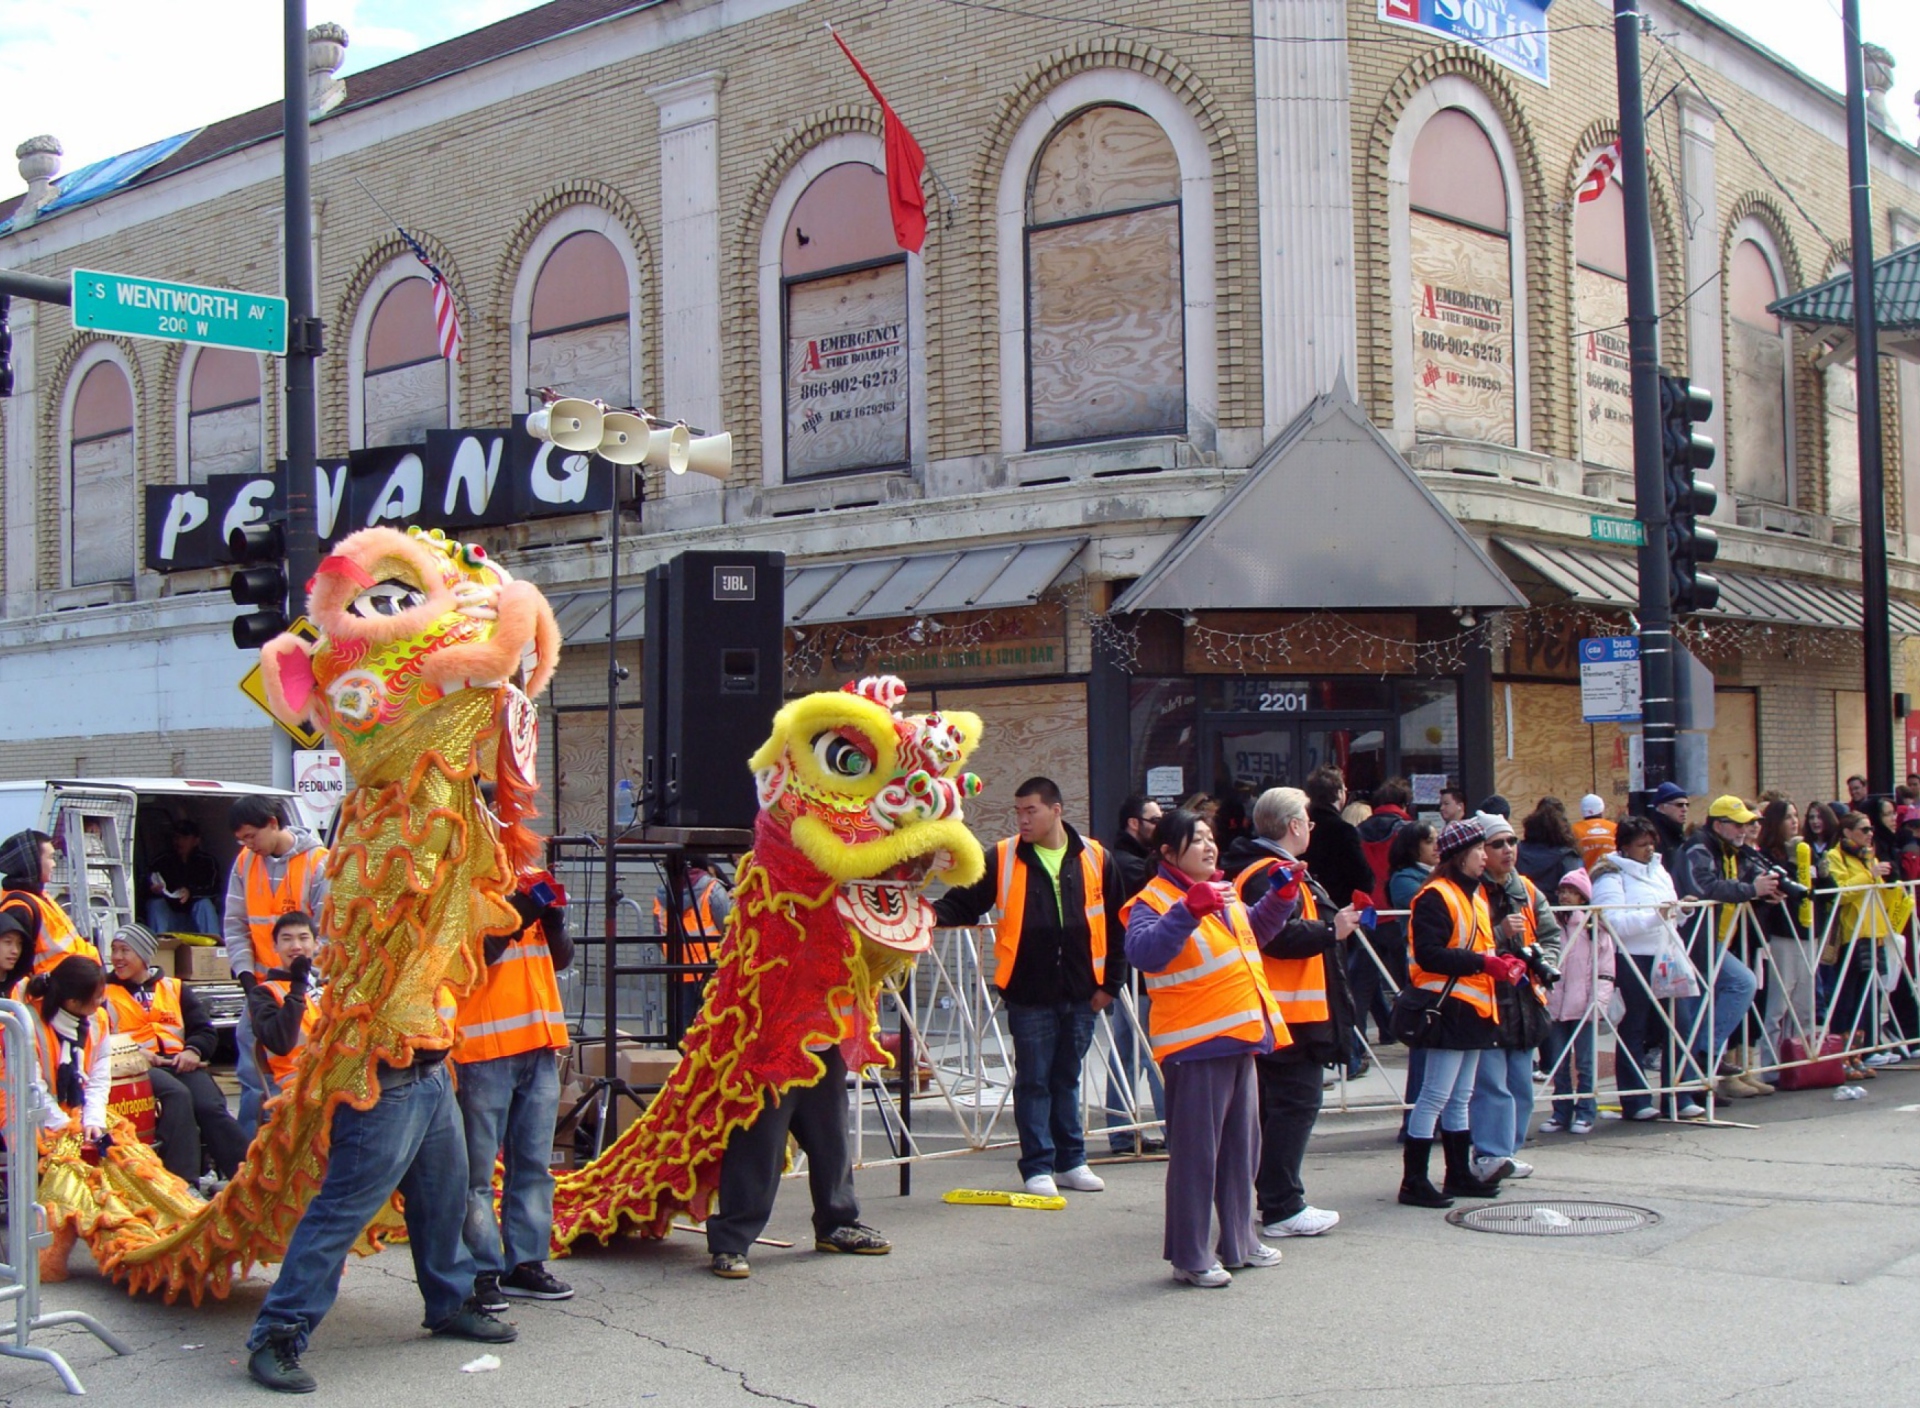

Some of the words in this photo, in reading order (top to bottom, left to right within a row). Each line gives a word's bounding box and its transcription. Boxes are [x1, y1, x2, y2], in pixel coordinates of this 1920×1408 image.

[95, 283, 106, 299] S
[116, 282, 238, 320] WENTWORTH
[248, 305, 266, 320] AV
[1420, 284, 1439, 319] A
[1435, 286, 1502, 316] EMERGENCY
[158, 316, 188, 334] 200
[196, 321, 209, 337] W
[800, 340, 821, 373] A
[820, 323, 901, 353] EMERGENCY
[826, 354, 849, 369] FIRE
[851, 346, 900, 365] BOARD-UP
[1422, 331, 1502, 364] 866-902-6273
[801, 368, 899, 400] 866-902-6273
[854, 401, 896, 419] 1679263
[1597, 519, 1637, 541] WENTWORTH
[722, 575, 748, 591] JBL
[1587, 646, 1601, 654] cta
[1612, 639, 1632, 649] bus
[1030, 645, 1053, 664] BAR
[1612, 649, 1636, 660] stop
[1259, 693, 1307, 711] 2201
[298, 780, 343, 792] PEDDLING
